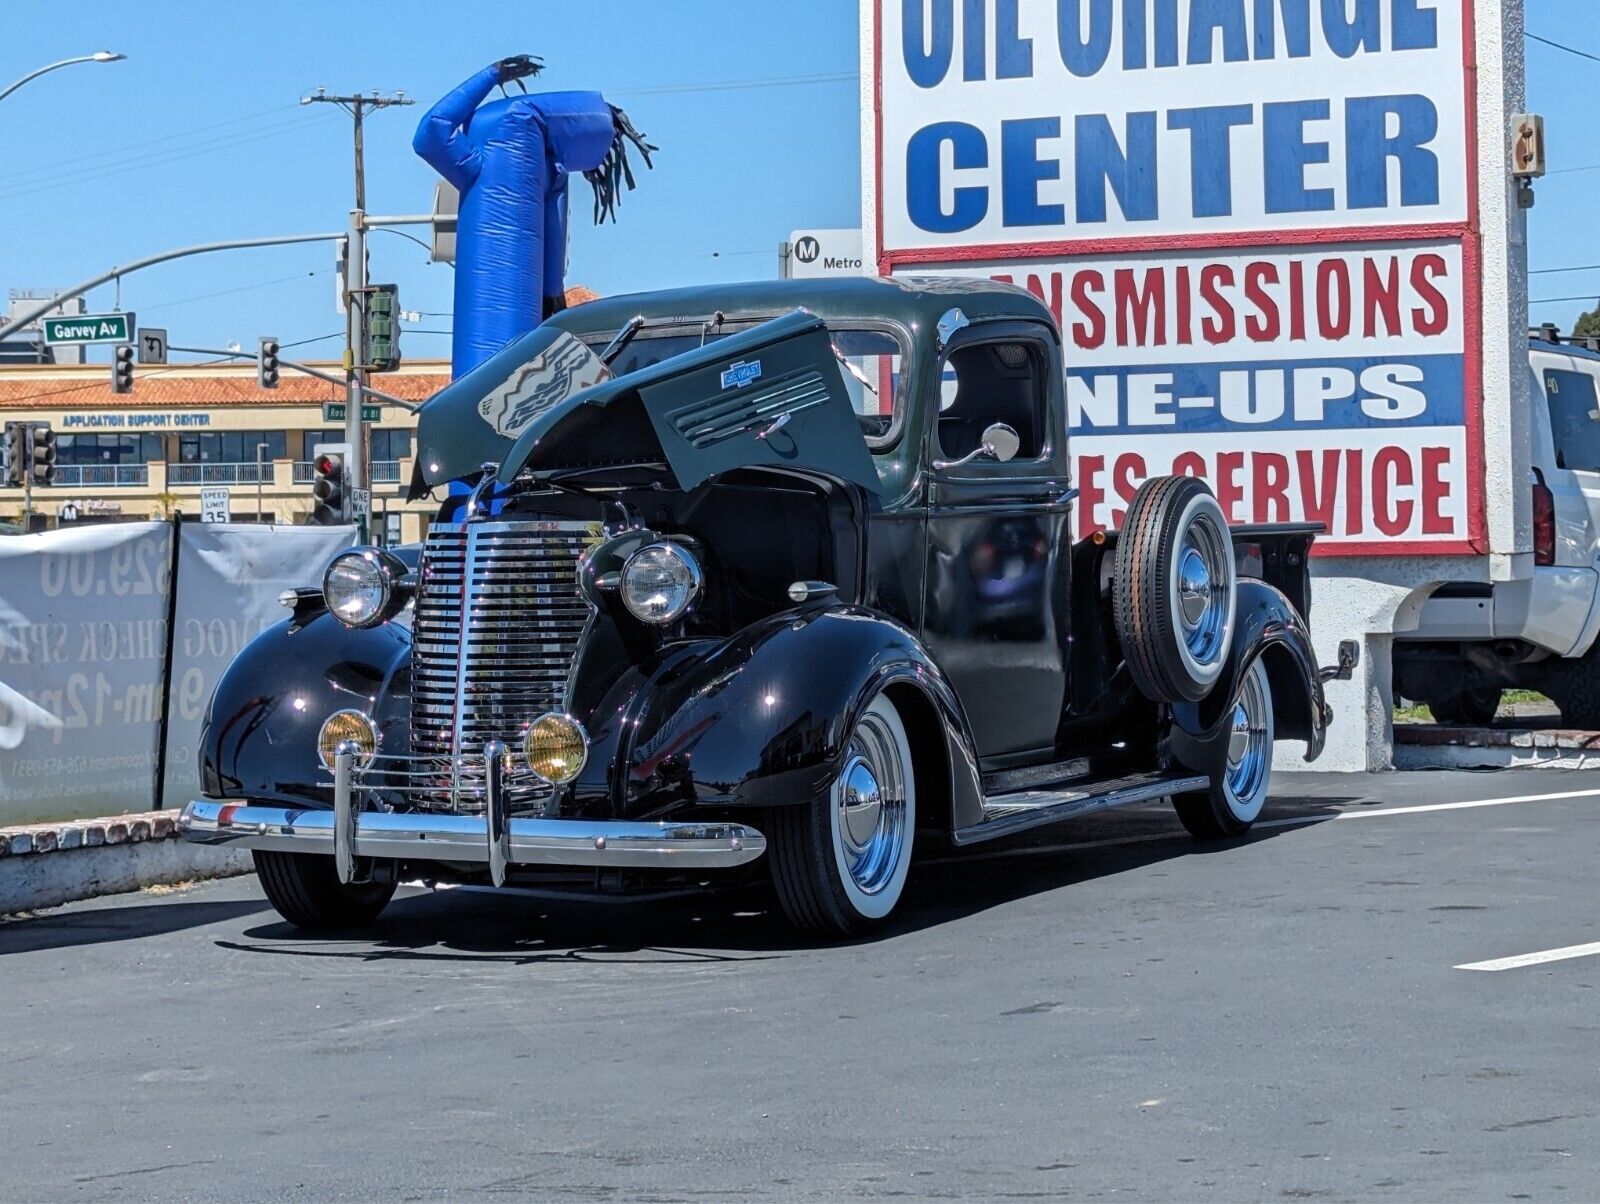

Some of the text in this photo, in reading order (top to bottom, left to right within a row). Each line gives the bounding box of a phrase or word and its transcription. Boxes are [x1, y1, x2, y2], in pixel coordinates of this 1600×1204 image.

[905, 93, 1440, 234] CENTER
[823, 257, 862, 269] Metro
[54, 321, 118, 339] Garvey Av
[1067, 364, 1427, 428] NE-UPS
[63, 413, 211, 427] APPLICATION SUPPORT CENTER
[353, 491, 368, 501] ONE
[206, 501, 225, 509] LIMIT
[352, 503, 369, 514] WAY
[206, 511, 226, 523] 35
